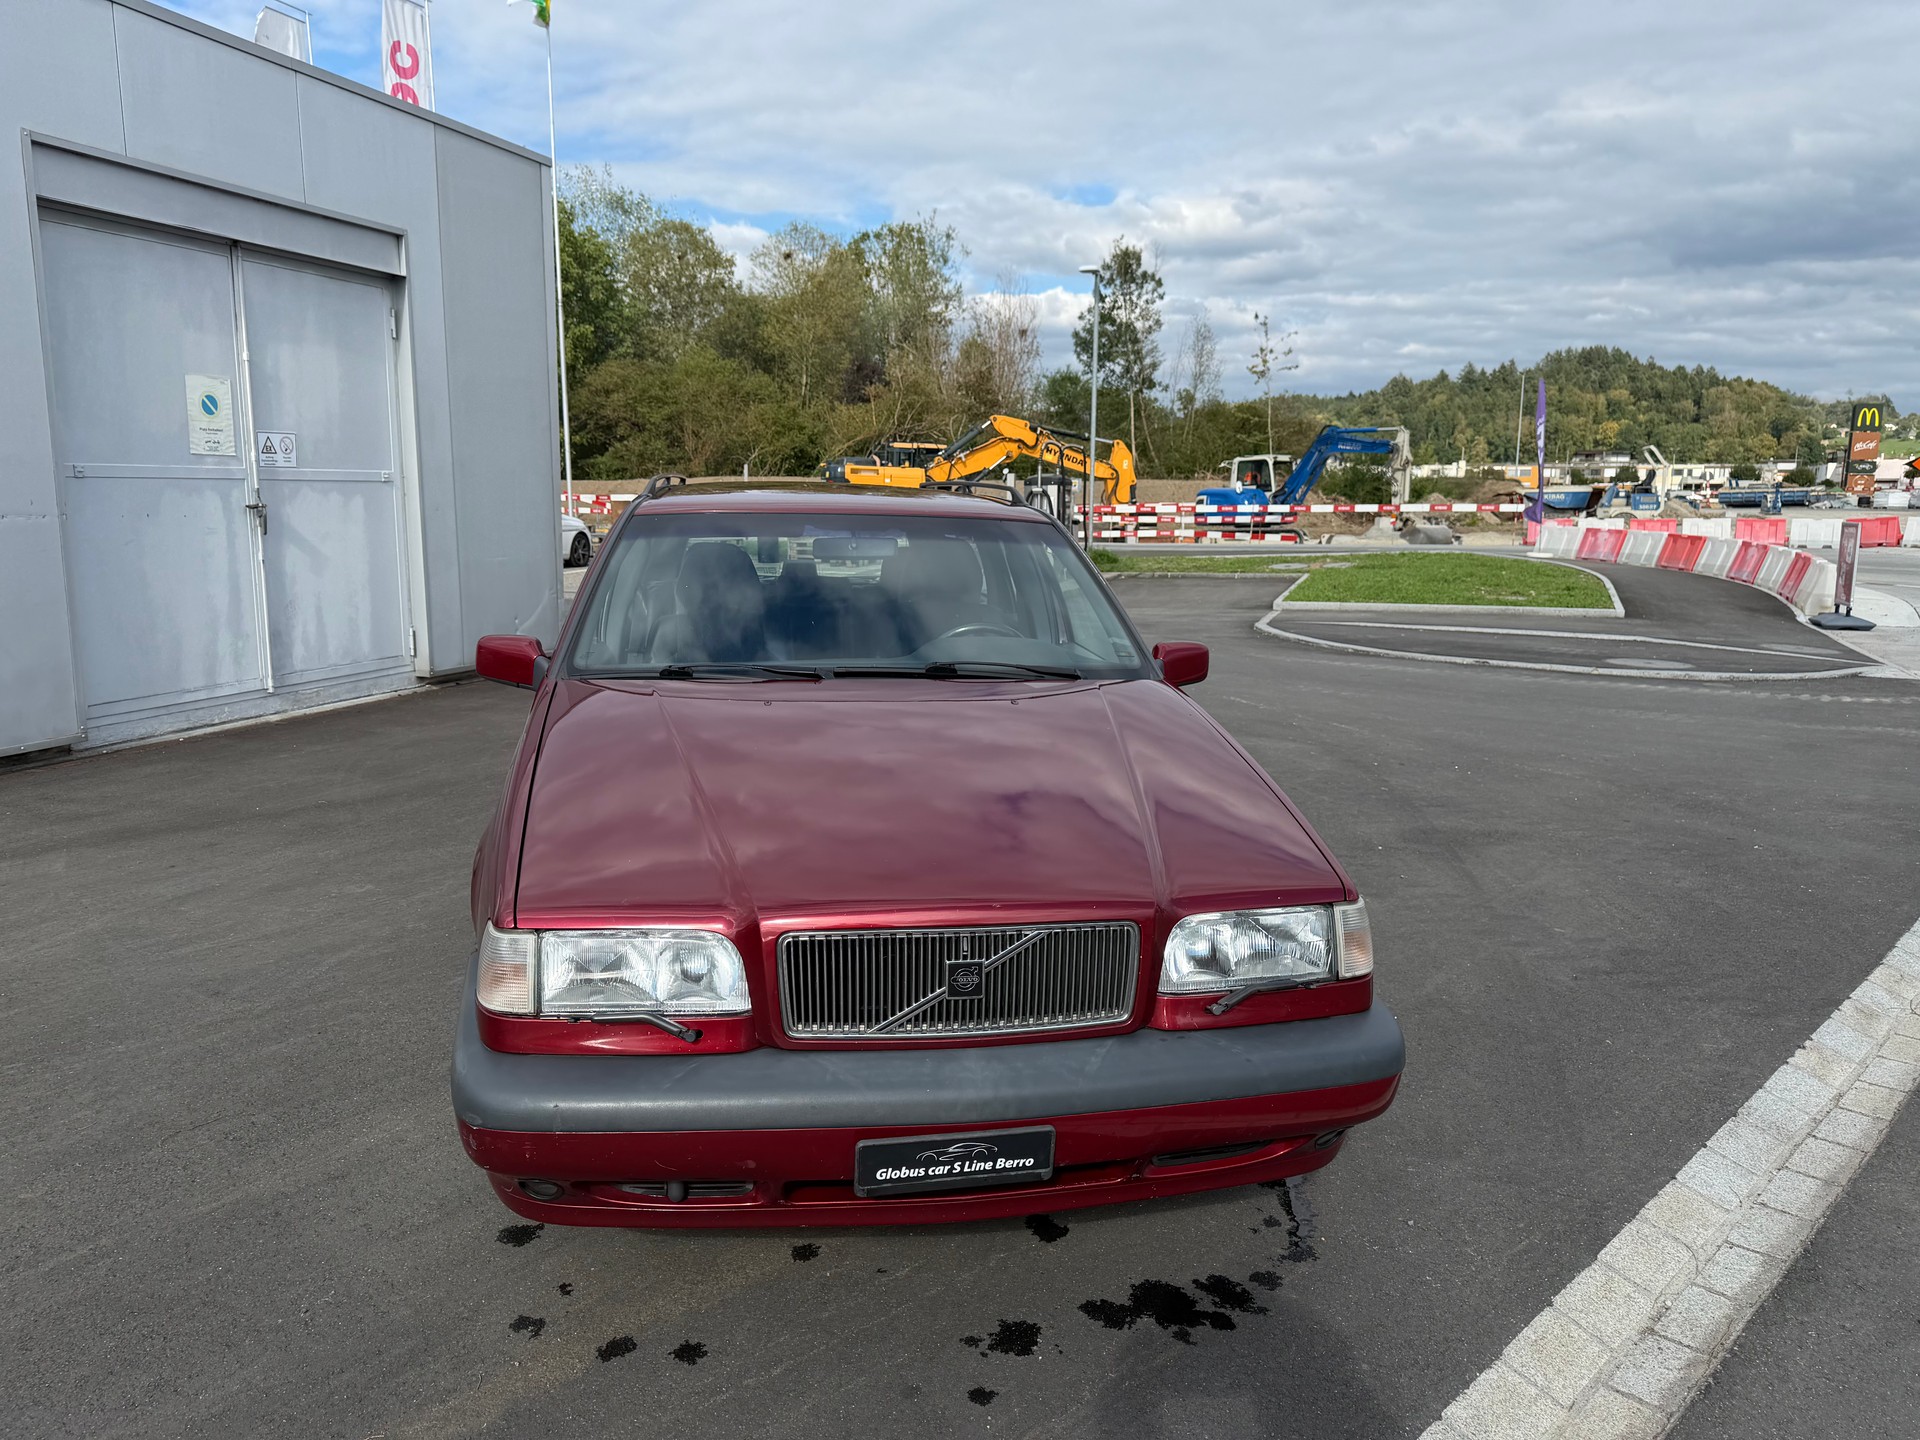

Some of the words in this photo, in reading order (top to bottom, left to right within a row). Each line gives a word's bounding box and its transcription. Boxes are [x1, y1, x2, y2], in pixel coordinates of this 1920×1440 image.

[875, 1166, 926, 1181] Globus
[928, 1165, 951, 1176] car
[952, 1161, 961, 1174] S
[963, 1159, 993, 1173] Line
[995, 1157, 1035, 1170] Berro
